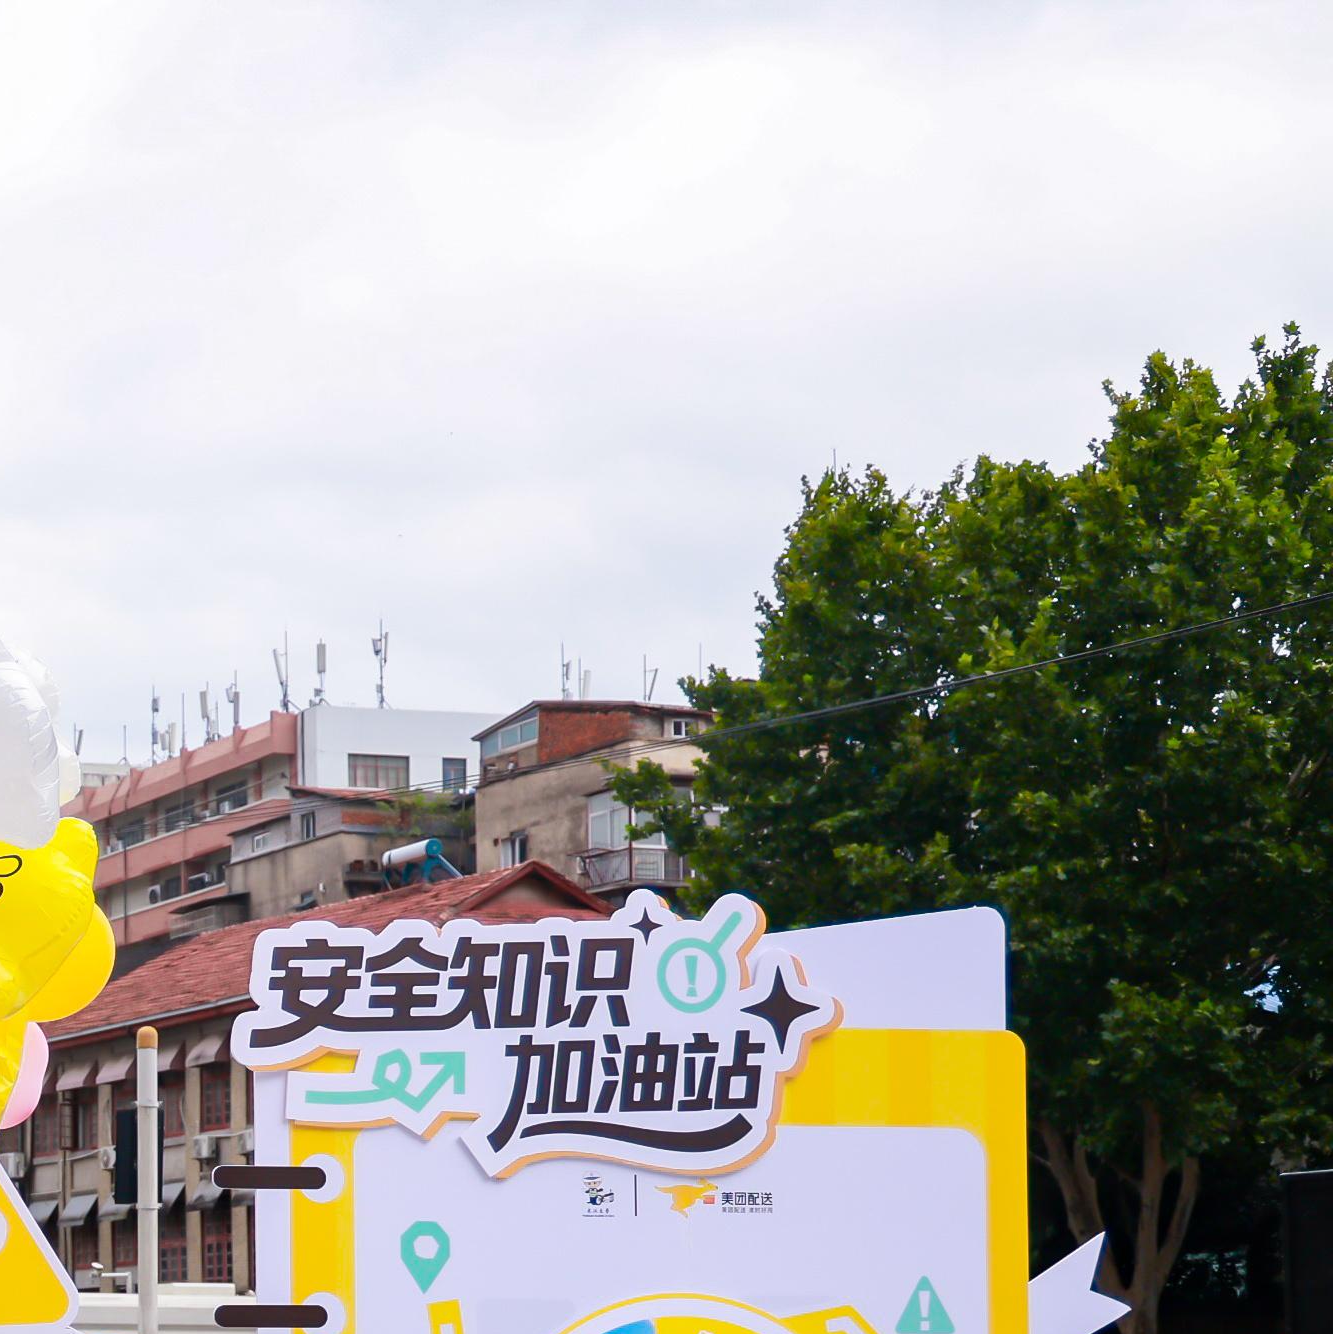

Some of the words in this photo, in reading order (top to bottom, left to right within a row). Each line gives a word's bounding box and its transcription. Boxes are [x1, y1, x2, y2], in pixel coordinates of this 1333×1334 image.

[250, 935, 636, 1049] 安全知识
[487, 1029, 766, 1154] 加油站
[721, 1192, 773, 1206] 美团配送
